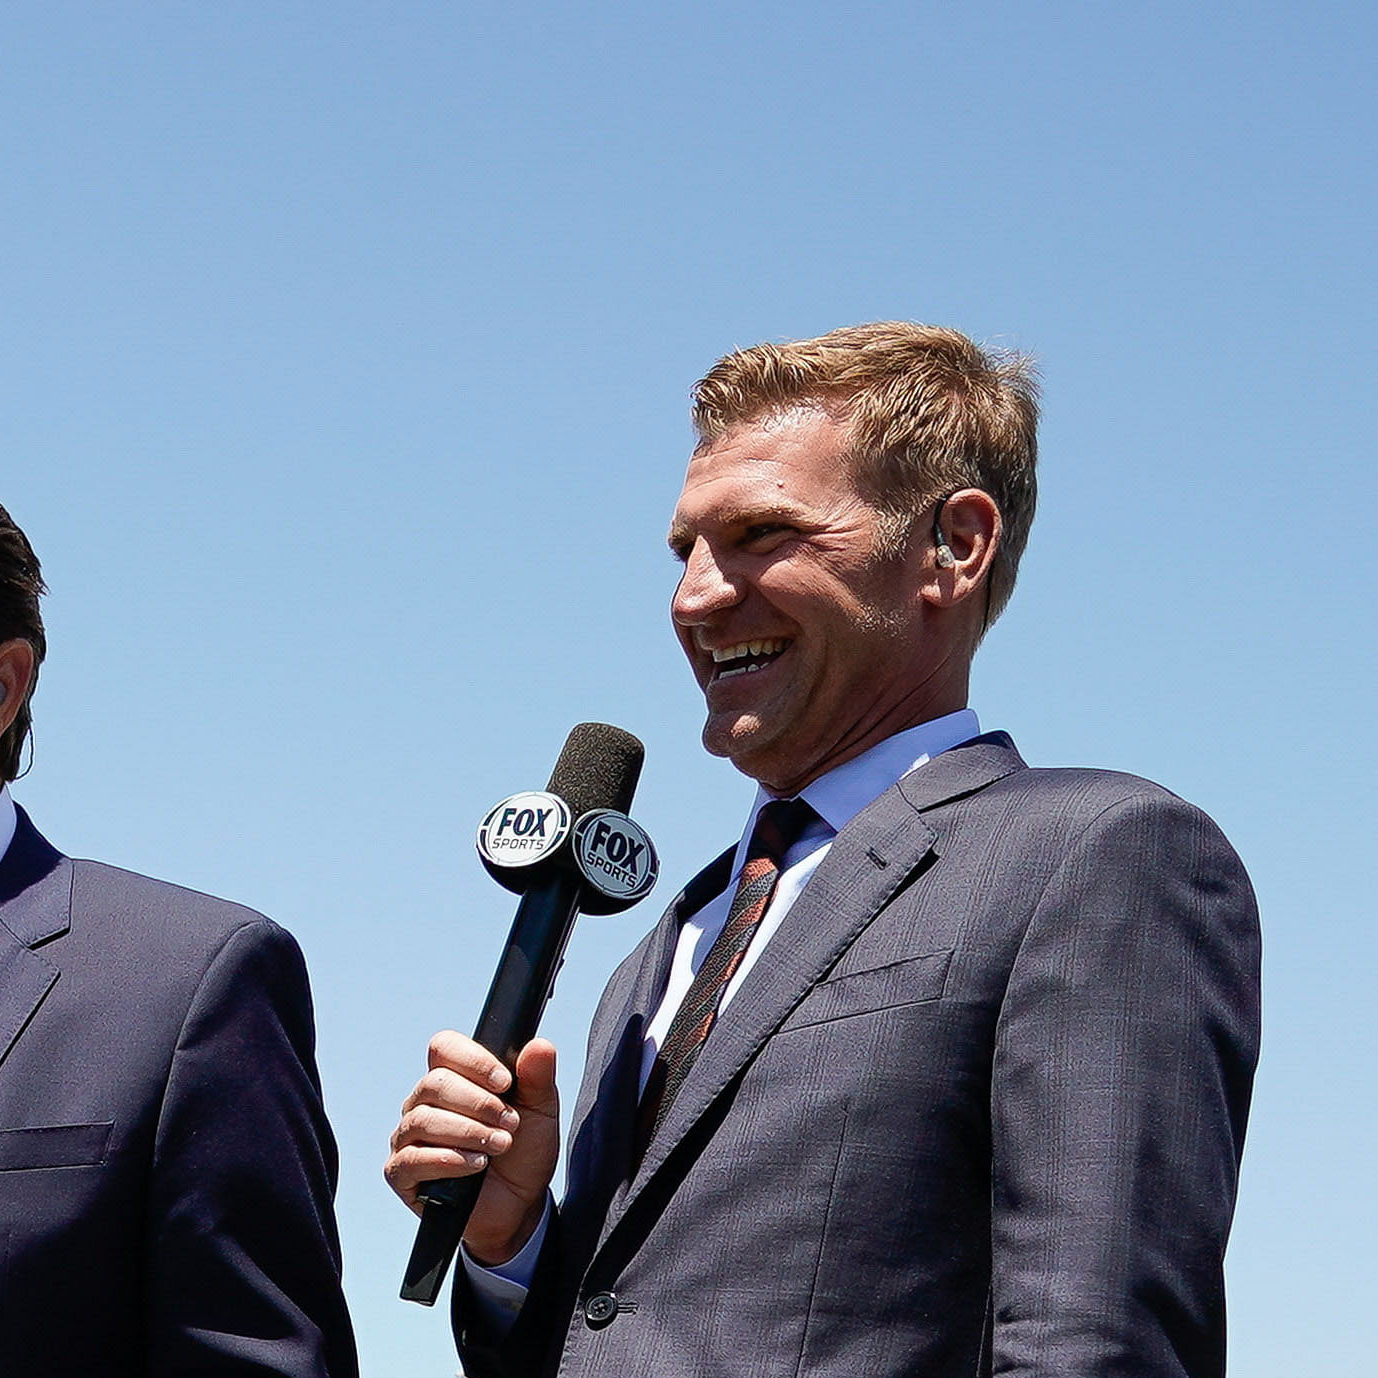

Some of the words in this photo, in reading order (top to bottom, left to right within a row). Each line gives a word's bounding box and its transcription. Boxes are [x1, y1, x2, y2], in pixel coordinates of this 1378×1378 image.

[497, 807, 554, 837] FOX
[491, 837, 545, 850] SPORTS
[590, 820, 645, 875] FOX
[586, 853, 638, 888] SPORTS
